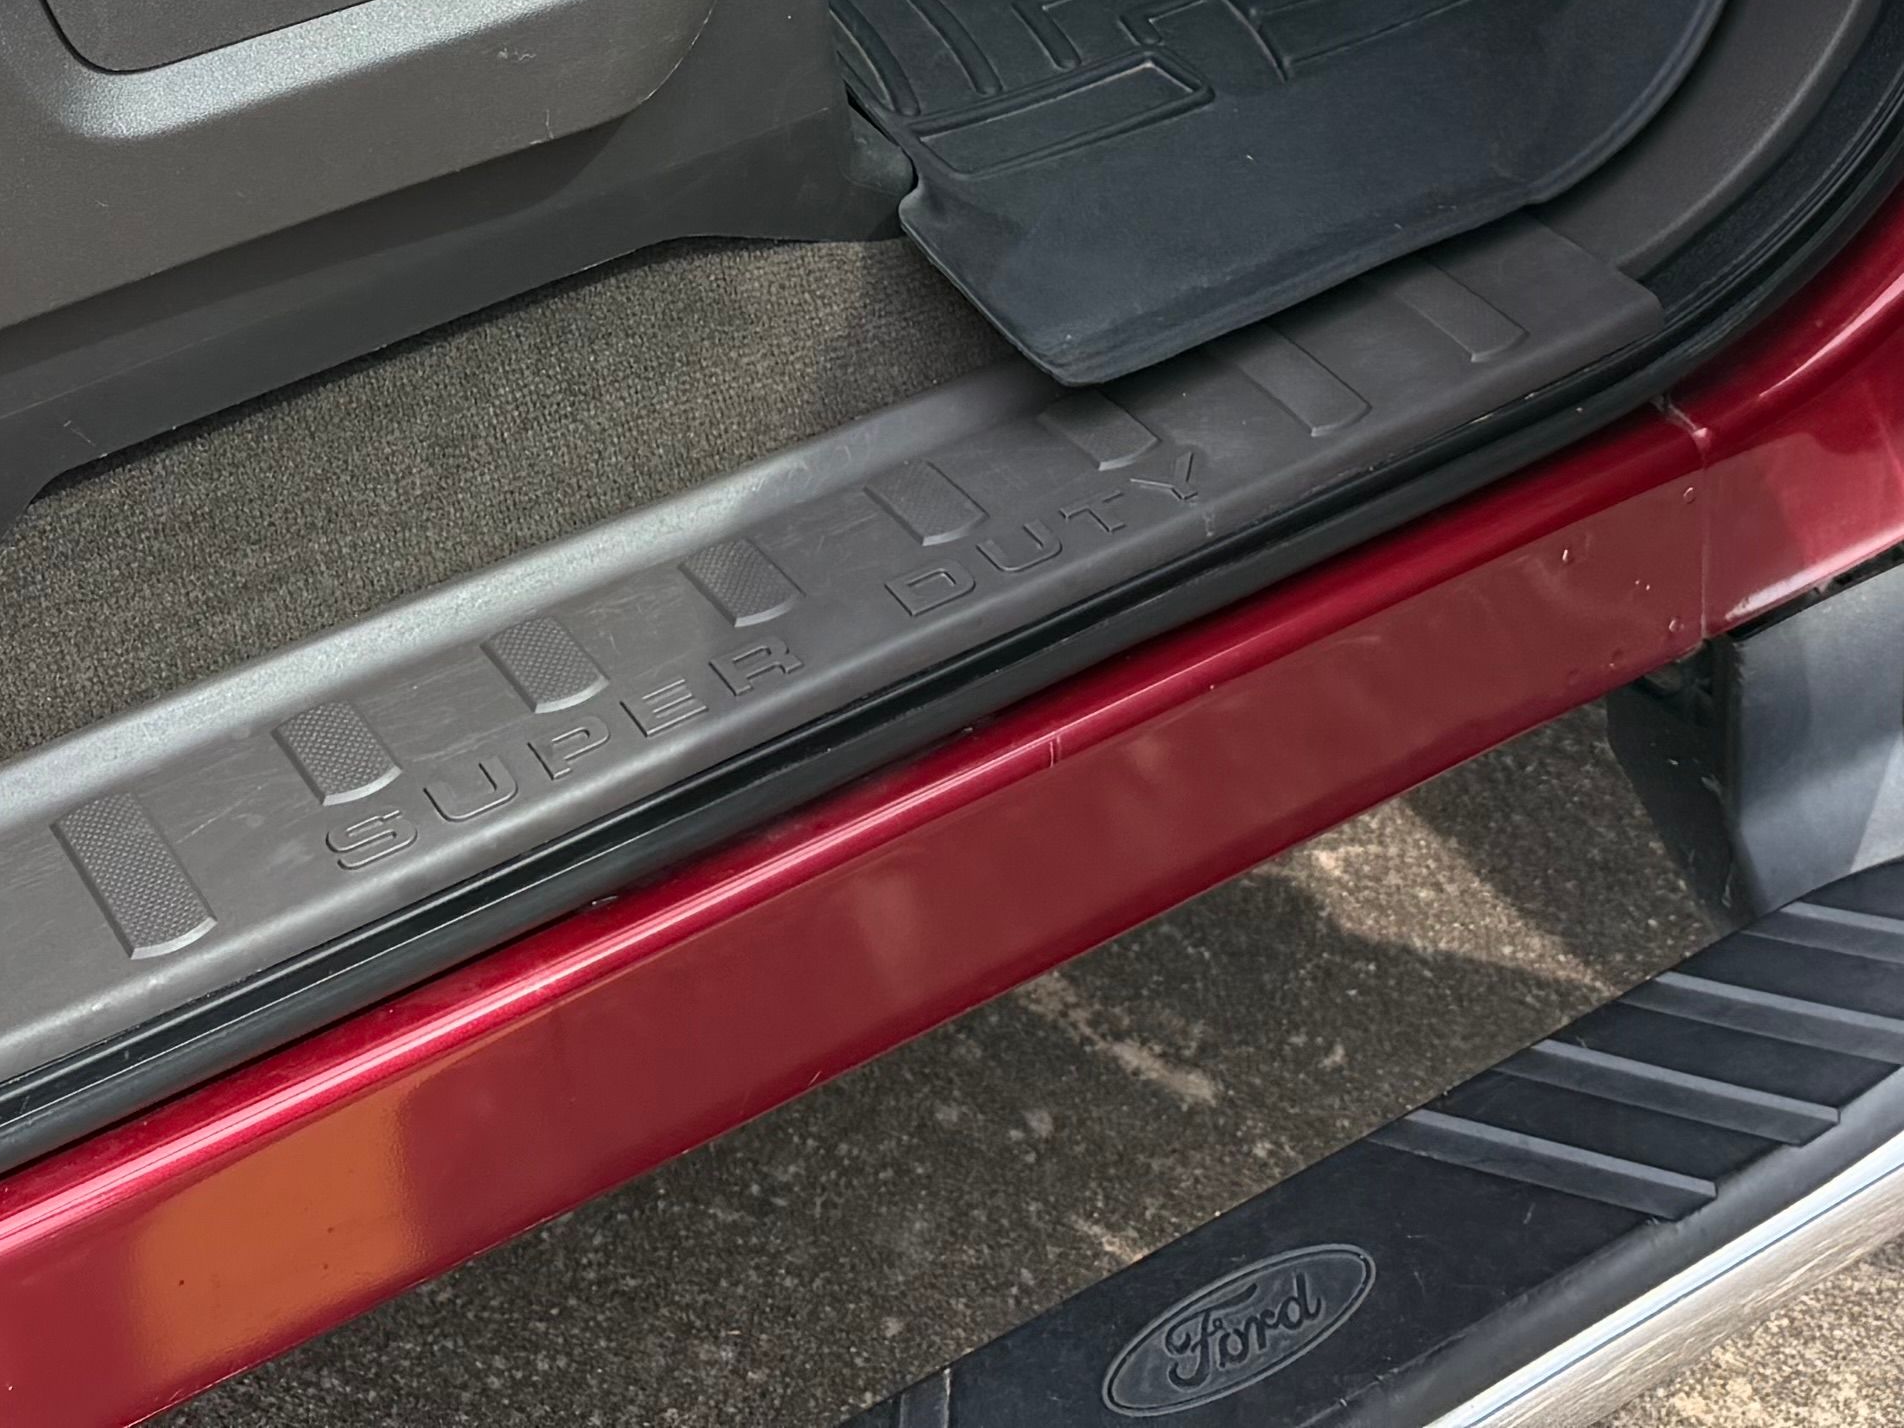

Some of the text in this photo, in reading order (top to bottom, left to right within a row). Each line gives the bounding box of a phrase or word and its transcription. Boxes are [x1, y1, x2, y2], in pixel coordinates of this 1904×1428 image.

[324, 451, 1197, 870] SUPER DUTY
[1165, 1272, 1322, 1387] Ford
